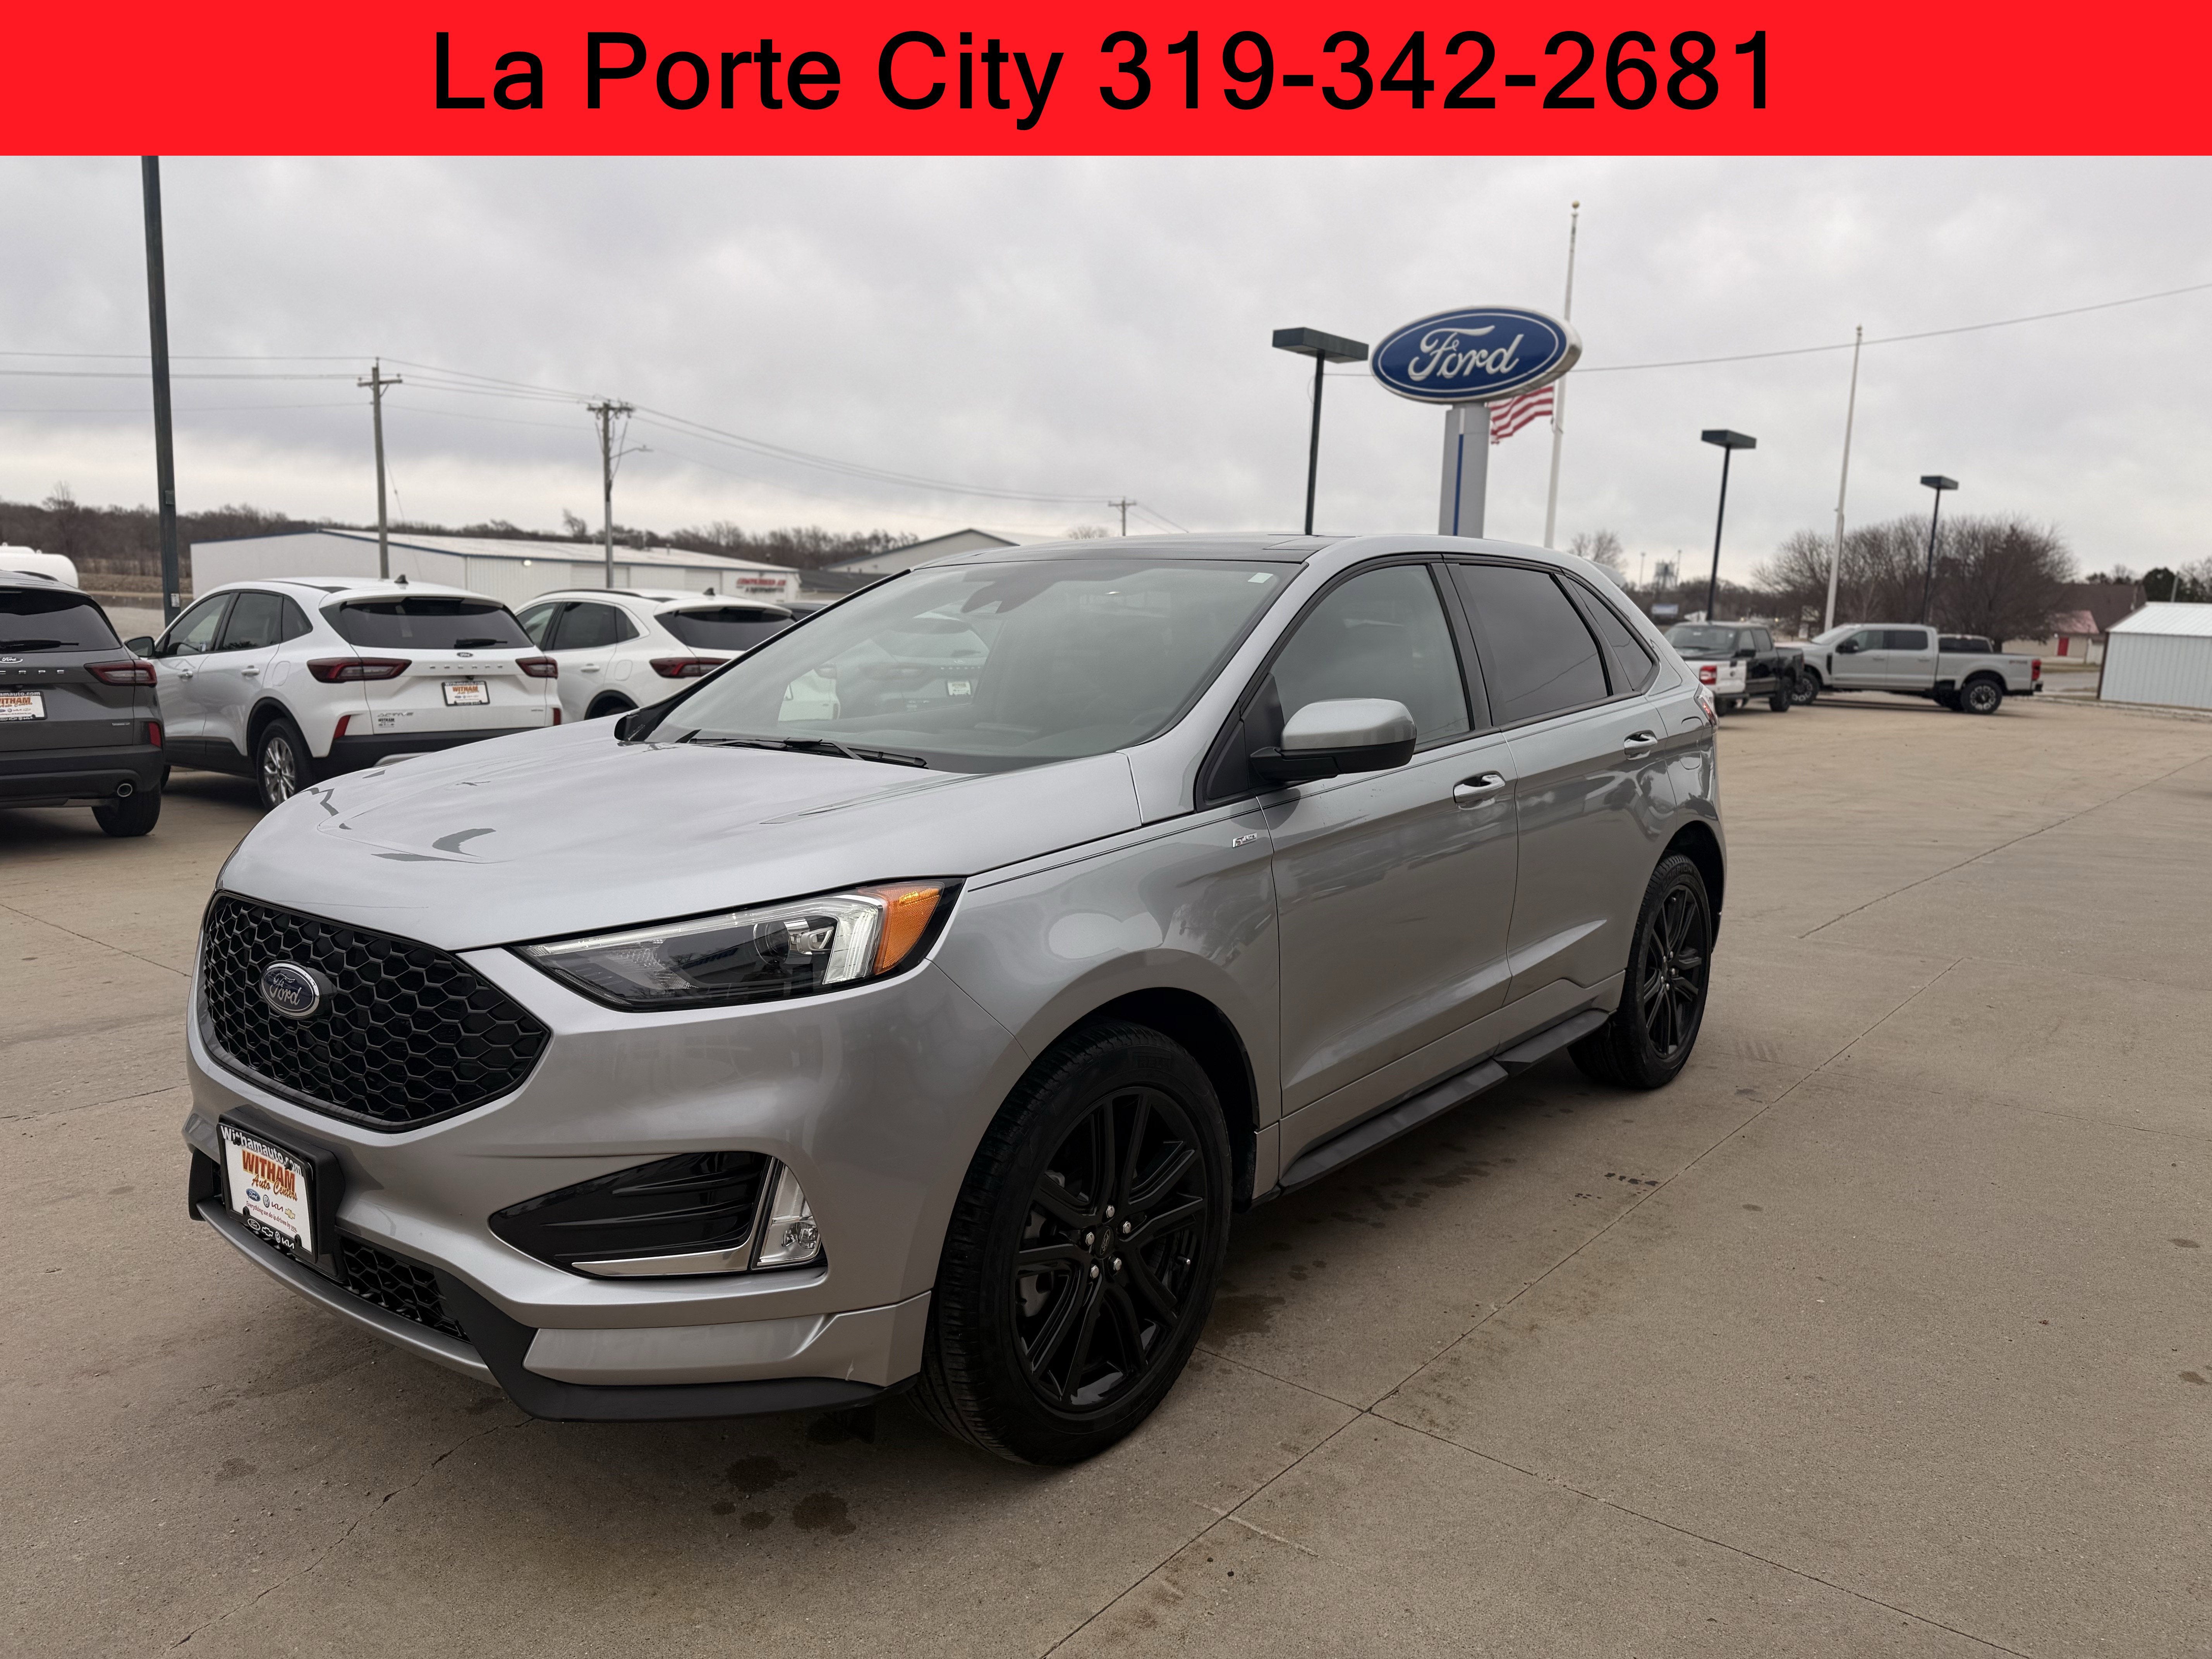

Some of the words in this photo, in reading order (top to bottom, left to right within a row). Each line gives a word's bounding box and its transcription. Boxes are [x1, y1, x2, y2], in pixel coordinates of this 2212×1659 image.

[1408, 325, 1524, 381] Ford
[270, 973, 302, 1006] Ford
[242, 1149, 295, 1193] WITHAM
[251, 1174, 271, 1191] Auto
[273, 1179, 297, 1202] Centers
[246, 1200, 263, 1215] Everything
